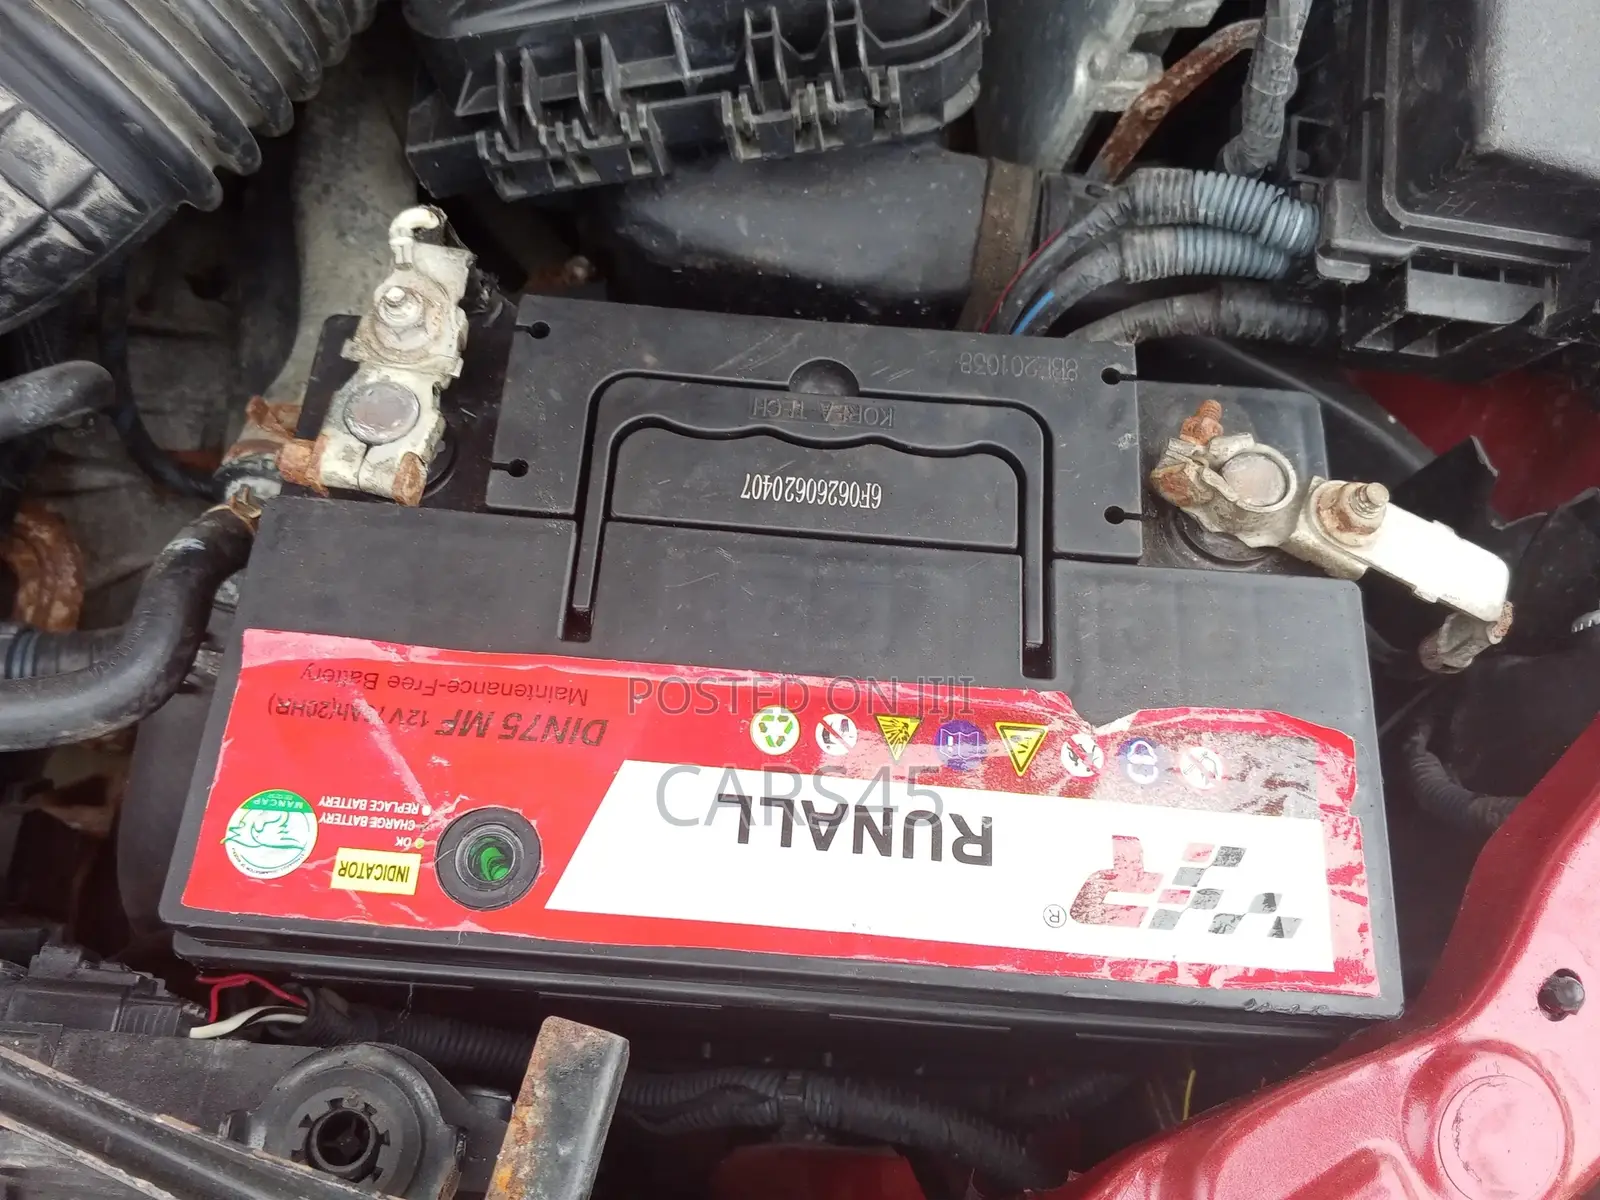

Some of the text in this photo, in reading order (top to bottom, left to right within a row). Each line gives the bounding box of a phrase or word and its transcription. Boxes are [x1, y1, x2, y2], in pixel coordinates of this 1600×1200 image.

[820, 400, 895, 427] KOREA
[740, 473, 882, 509] 6F06260620407
[301, 663, 588, 706] Maintenance-Free Battery
[268, 693, 609, 746] DIN75 MF 12V 7Ah(20HR)
[253, 797, 304, 809] MANCAP
[318, 795, 419, 815] REPLACE BATTERY
[318, 812, 416, 831] CHARGE BATTERY
[717, 793, 993, 867] RUNALL
[395, 836, 412, 848] OK
[337, 860, 410, 883] INDICATOR
